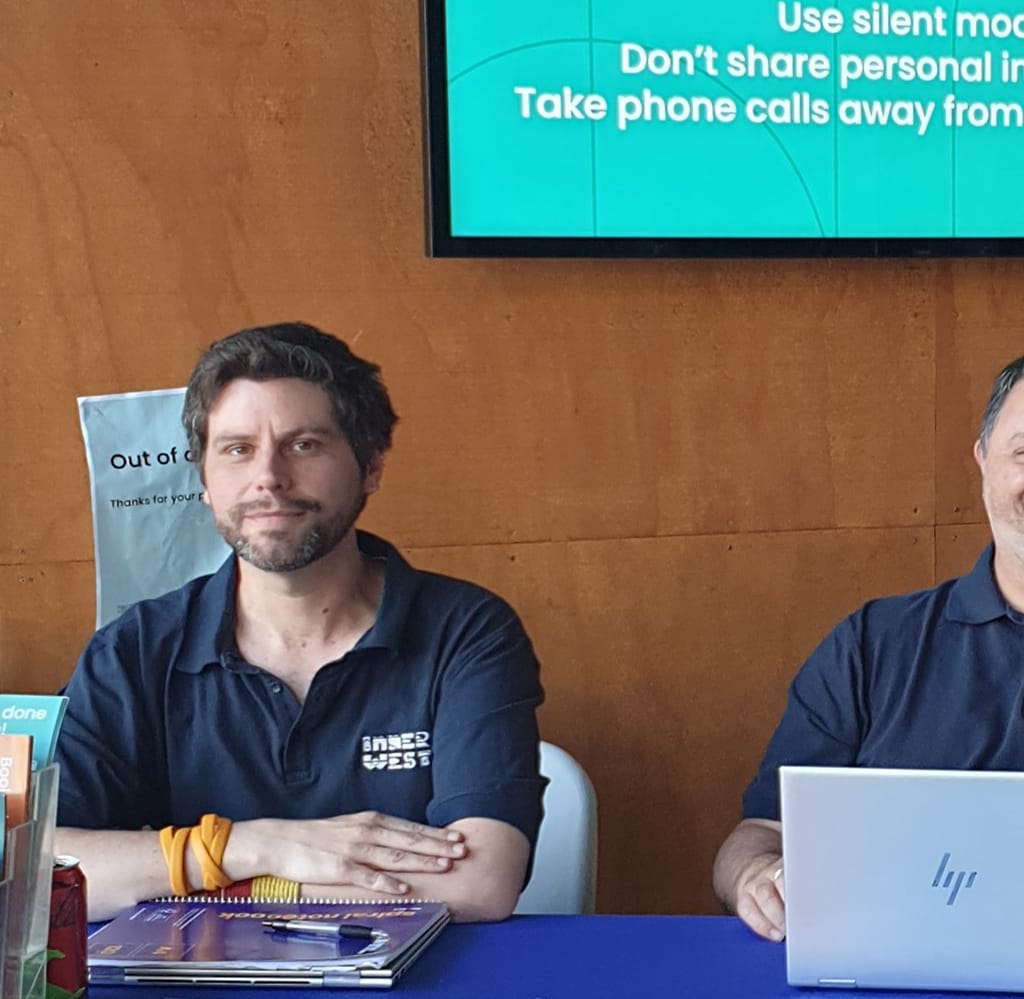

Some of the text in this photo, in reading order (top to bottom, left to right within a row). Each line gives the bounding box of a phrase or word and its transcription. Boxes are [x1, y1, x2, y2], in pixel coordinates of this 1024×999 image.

[778, 1, 844, 34] Use
[852, 2, 947, 37] silent
[620, 42, 718, 76] Don't
[727, 46, 830, 79] share
[840, 50, 992, 88] personal
[514, 86, 606, 120] Take
[617, 89, 737, 130] phone
[745, 93, 830, 124] calls
[838, 101, 935, 136] away
[943, 95, 1024, 127] from
[110, 452, 151, 470] Out
[156, 446, 178, 465] of
[110, 496, 151, 508] Thanks
[152, 494, 168, 504] for
[171, 493, 196, 506] your
[1, 705, 48, 720] done
[362, 731, 431, 752] INNER
[362, 749, 432, 770] WEST
